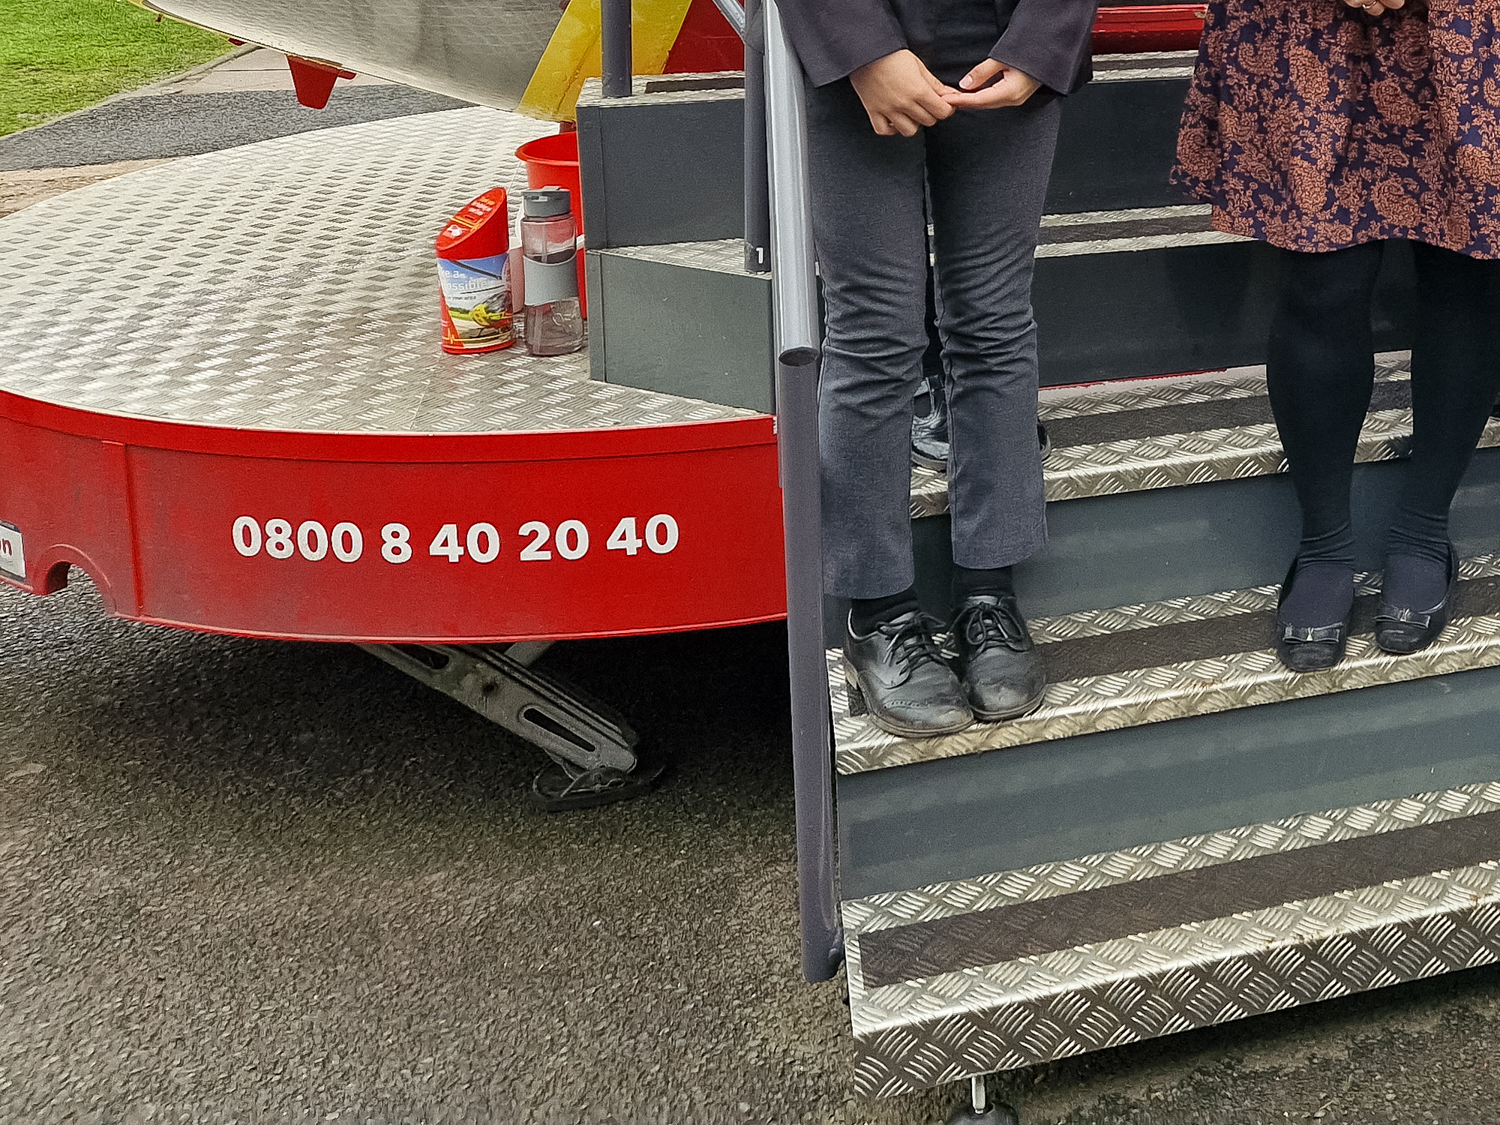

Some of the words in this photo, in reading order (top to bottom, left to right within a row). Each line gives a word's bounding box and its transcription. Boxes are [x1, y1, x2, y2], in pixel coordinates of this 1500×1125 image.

[232, 515, 363, 563] 0800
[380, 521, 413, 564] 8
[428, 521, 501, 563] 40
[517, 519, 590, 562] 20
[606, 513, 680, 556] 40
